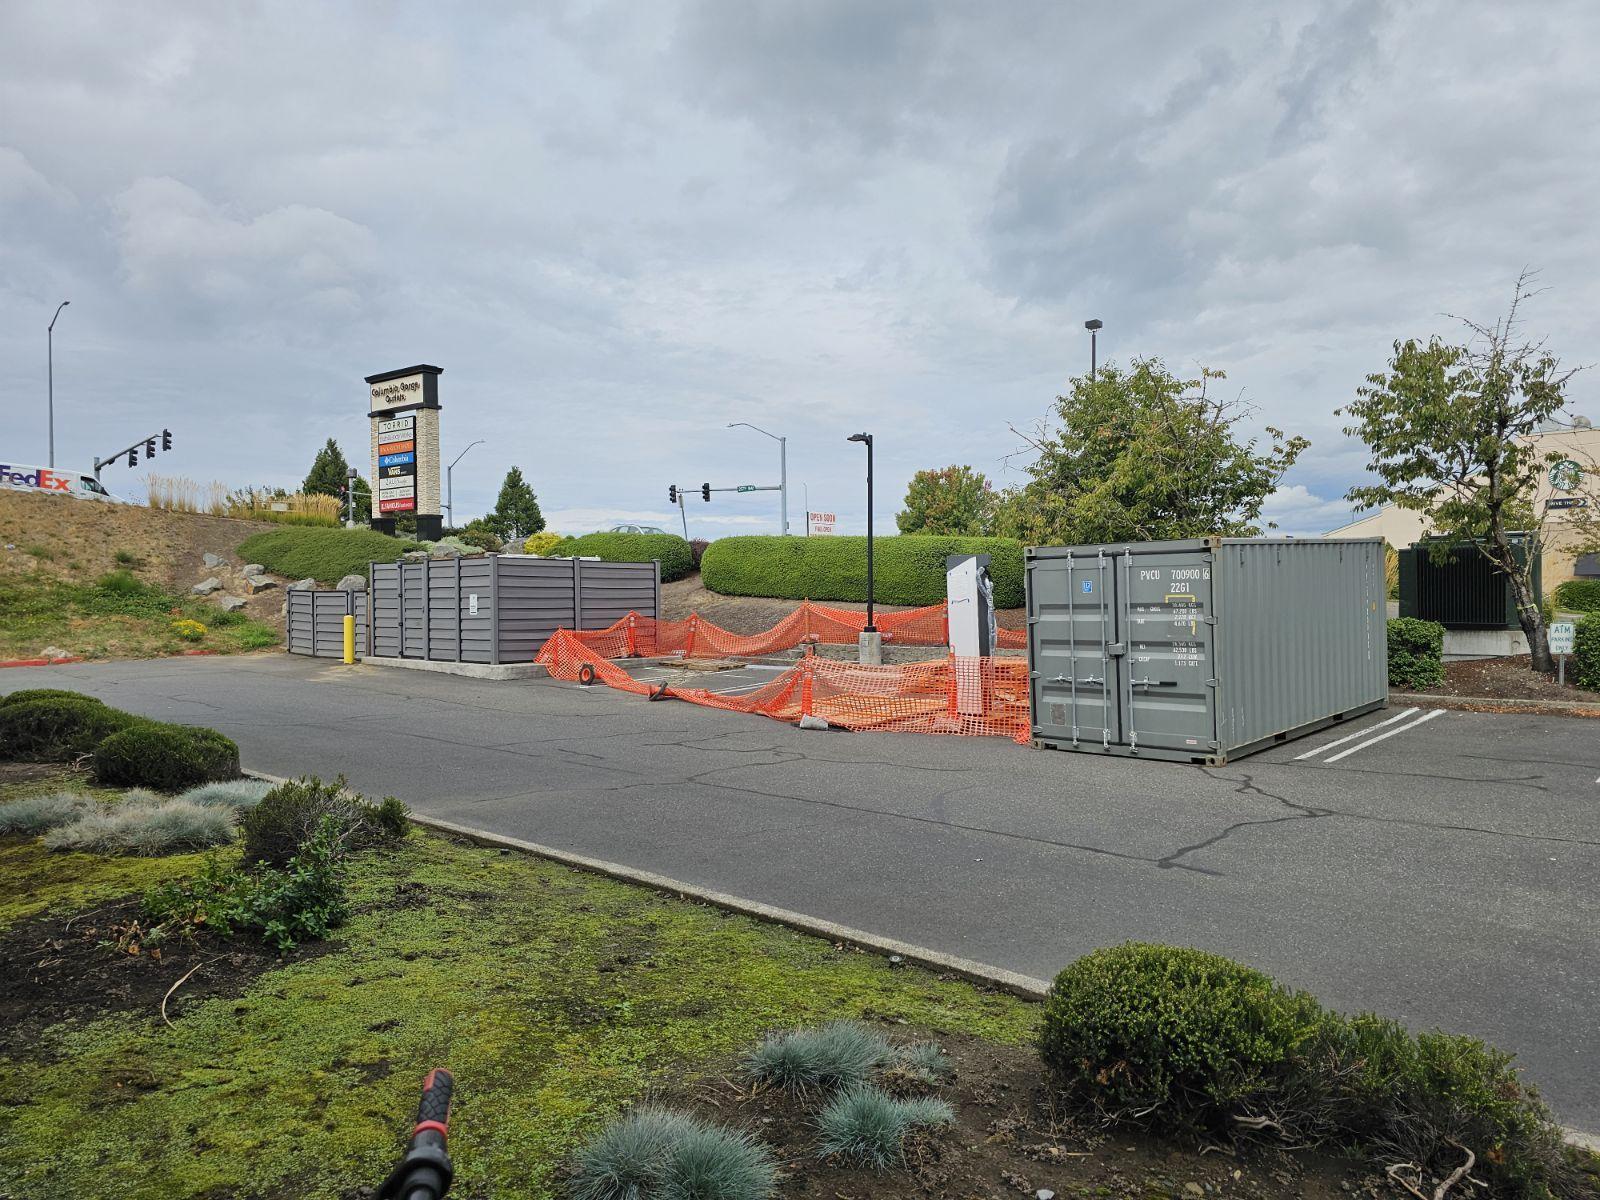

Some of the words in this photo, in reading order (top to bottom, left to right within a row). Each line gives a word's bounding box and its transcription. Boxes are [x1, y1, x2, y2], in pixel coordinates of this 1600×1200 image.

[384, 420, 409, 429] TORRID
[387, 466, 401, 476] VANS
[0, 465, 70, 491] FedEx
[1140, 570, 1160, 580] PVCU
[1171, 569, 1200, 580] 700900
[1170, 582, 1189, 593] 22G1
[1554, 626, 1571, 634] ATM
